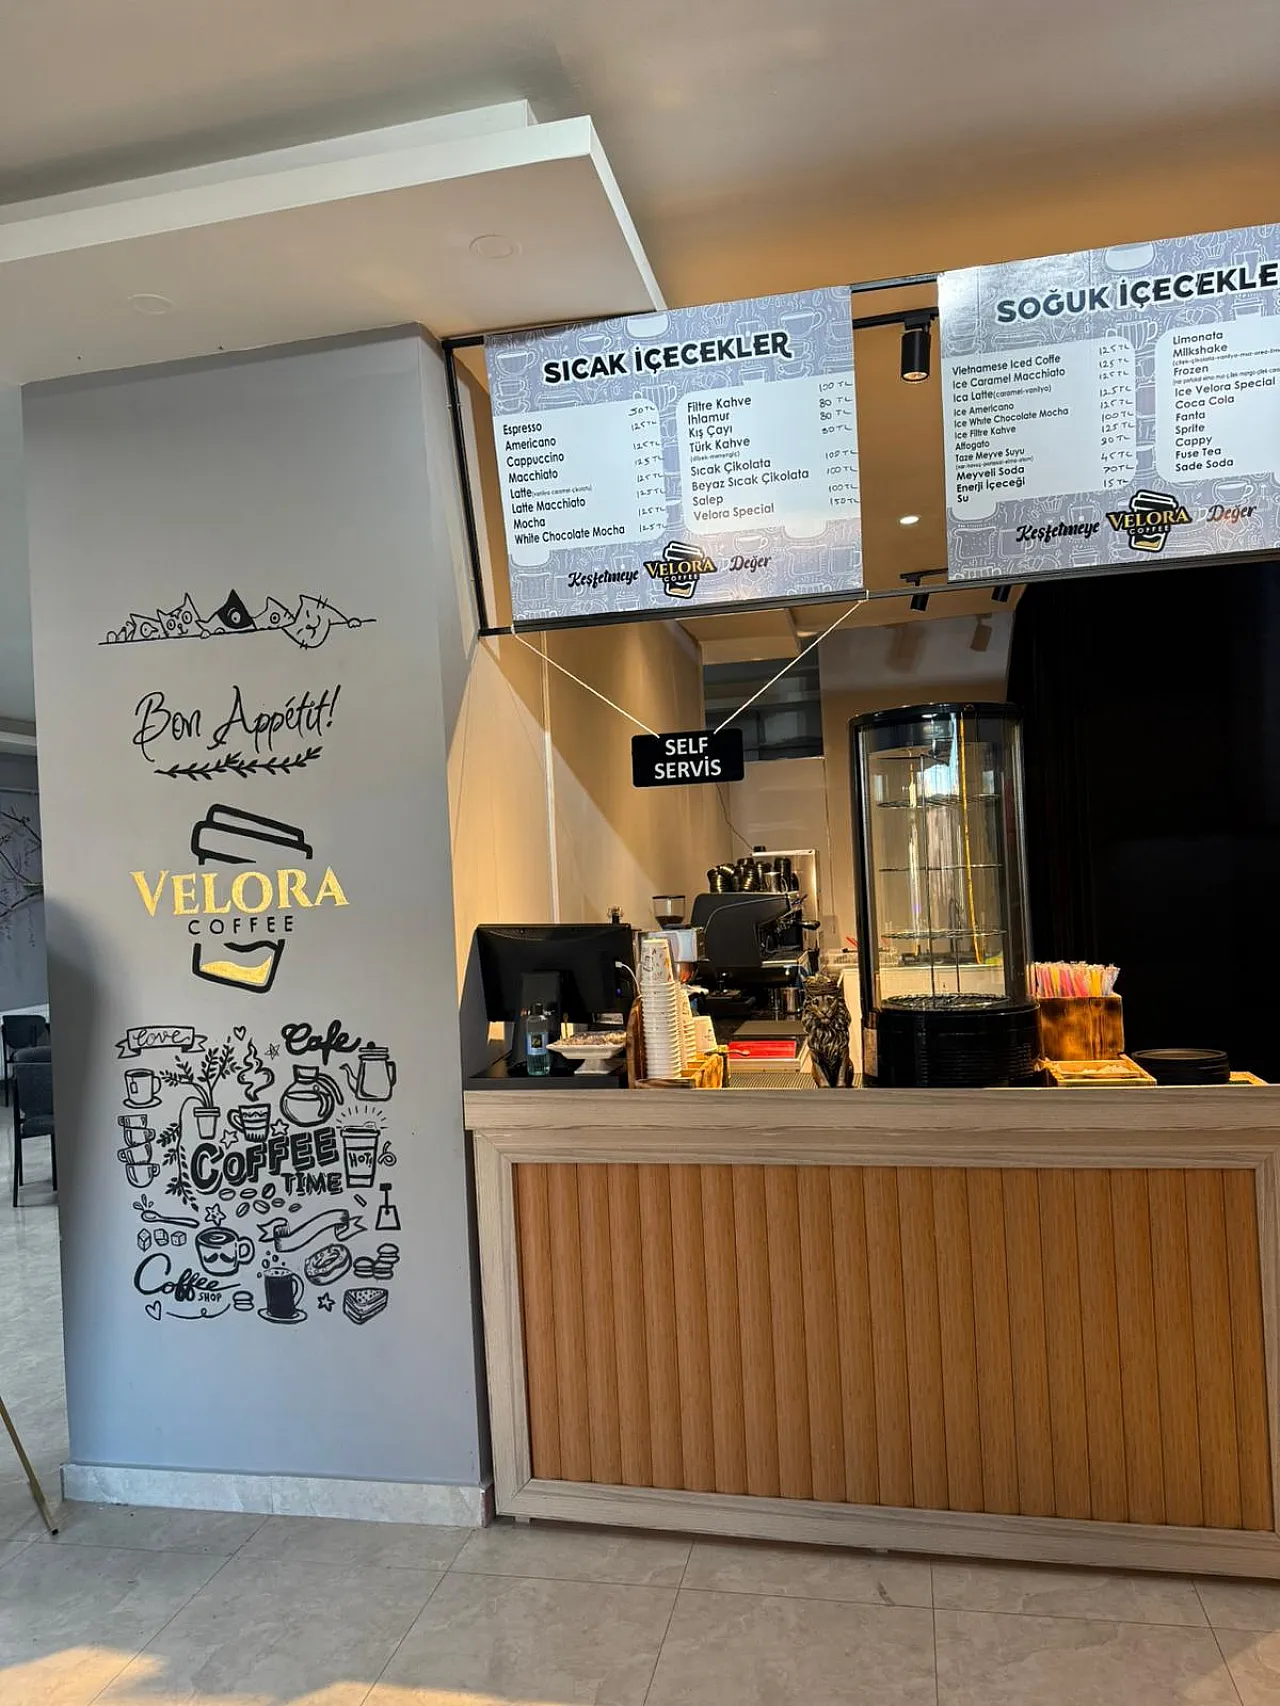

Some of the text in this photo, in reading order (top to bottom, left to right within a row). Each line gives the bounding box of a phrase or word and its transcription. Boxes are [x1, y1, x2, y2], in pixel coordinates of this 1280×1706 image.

[996, 286, 1109, 323] SOĞUK
[1172, 331, 1224, 345] Limonata
[544, 332, 792, 384] SICAK İÇECEKLER
[1172, 343, 1228, 358] Milkshake
[952, 354, 1061, 376] Vietnamese Iced Coffe
[1173, 365, 1209, 377] Frozen
[953, 368, 1066, 389] Ice Caramel Macchiato
[1174, 388, 1192, 397] Ice
[1195, 383, 1231, 395] Velora
[1234, 376, 1276, 391] Special
[687, 396, 752, 413] Filtre Kahve
[819, 398, 832, 408] 80
[953, 393, 969, 403] Ica
[1175, 395, 1235, 410] Coca Cola
[954, 402, 1014, 417] Ice Americano
[954, 407, 1069, 428] Ice White Chocolate Mocha
[1175, 411, 1206, 422] Fanta
[688, 412, 730, 425] Ihlamur
[503, 422, 542, 437] Espresso
[689, 425, 733, 439] Kış Çayı
[954, 425, 1017, 439] Ice Filtre Kahve
[1175, 423, 1205, 436] Sprite
[505, 437, 556, 451] Americano
[690, 437, 751, 452] Türk Kahve
[955, 440, 990, 451] Affogato
[1175, 436, 1213, 447] Cappy
[507, 452, 564, 468] Cappuccino
[955, 453, 974, 463] Taze
[976, 450, 1003, 462] Meyve
[1005, 448, 1025, 459] Suyu
[1175, 447, 1222, 460] Fuse Tea
[691, 458, 771, 477] Sıcak Çikolata
[956, 468, 996, 481] Meyveli
[1000, 465, 1025, 476] Soda
[1175, 458, 1234, 472] Sade Soda
[508, 468, 558, 483] Macchiato
[692, 469, 809, 493] Beyaz Sıcak Çikolata
[956, 477, 1025, 493] Enerji İçeceği
[512, 497, 586, 514] Latte Macchiato
[692, 495, 724, 507] Salep
[957, 494, 969, 503] Su
[693, 503, 775, 521] Velora Special
[1108, 509, 1190, 531] VELORA
[1206, 504, 1257, 524] Değer
[513, 517, 546, 530] Mocha
[515, 524, 625, 545] White Chocolate Mocha
[1016, 522, 1100, 543] Keşfetmeye
[646, 557, 716, 577] VELORA
[729, 555, 772, 573] Değer
[568, 569, 639, 590] Keşfetmeye
[132, 685, 341, 762] Bon Appétit!
[665, 737, 708, 756] SELF
[654, 756, 721, 779] SERVİS
[129, 866, 350, 917] VELORA
[188, 915, 294, 935] COFFEE
[281, 1020, 361, 1065] Cafe
[191, 1126, 339, 1195] COFFEE
[281, 1172, 342, 1195] TIME
[134, 1252, 240, 1302] Coffee
[198, 1292, 222, 1302] SHOP
